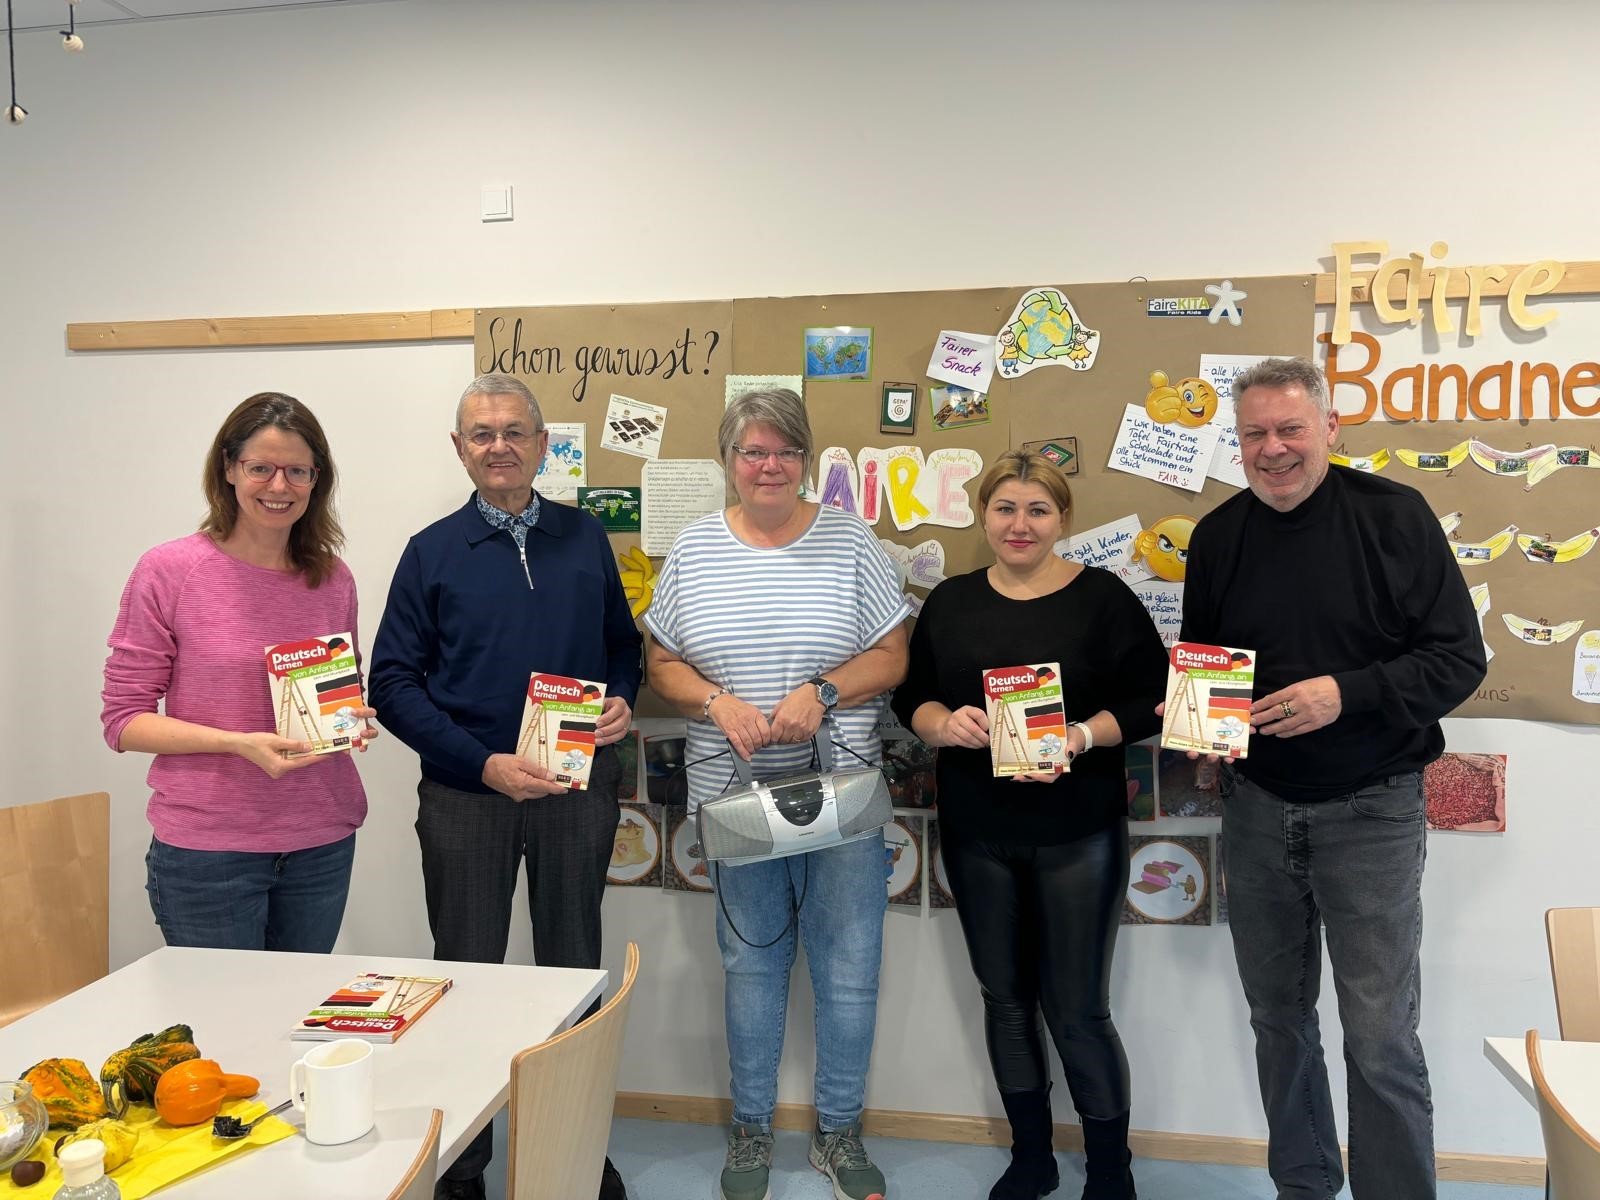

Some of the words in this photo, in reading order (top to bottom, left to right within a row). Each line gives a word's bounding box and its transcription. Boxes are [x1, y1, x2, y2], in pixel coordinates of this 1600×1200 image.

[1331, 240, 1567, 344] Faire
[480, 317, 566, 376] Schon
[941, 336, 978, 357] Fairer
[941, 357, 982, 377] Snack
[1211, 366, 1227, 376] alle
[1317, 331, 1600, 425] Banane
[1215, 385, 1234, 398] Sch
[1129, 428, 1151, 441] Tafel
[1152, 422, 1176, 438] haben
[1179, 433, 1198, 444] eine
[1129, 439, 1174, 458] Schokolade
[1175, 454, 1194, 464] und
[1119, 457, 1141, 470] Stück
[1133, 450, 1178, 470] bekommen
[1179, 464, 1194, 474] ein
[1158, 471, 1179, 485] FAIR
[1062, 551, 1074, 560] es
[1075, 542, 1093, 559] gibt
[1083, 548, 1123, 566] arbeiten
[272, 646, 326, 664] Deutsch
[1176, 648, 1228, 665] Deutsch
[273, 660, 303, 671] lernen
[291, 670, 307, 679] von
[308, 663, 338, 675] Anfang
[338, 660, 349, 668] an
[1176, 659, 1203, 668] lernen
[988, 672, 1035, 687] Deutsch
[1206, 671, 1236, 680] Anfang
[533, 690, 558, 700] lernen
[534, 680, 581, 697] Deutsch
[989, 685, 1015, 694] lernen
[1019, 690, 1045, 699] Anfang
[559, 703, 585, 713] Anfang
[331, 1019, 396, 1030] Deutsch
